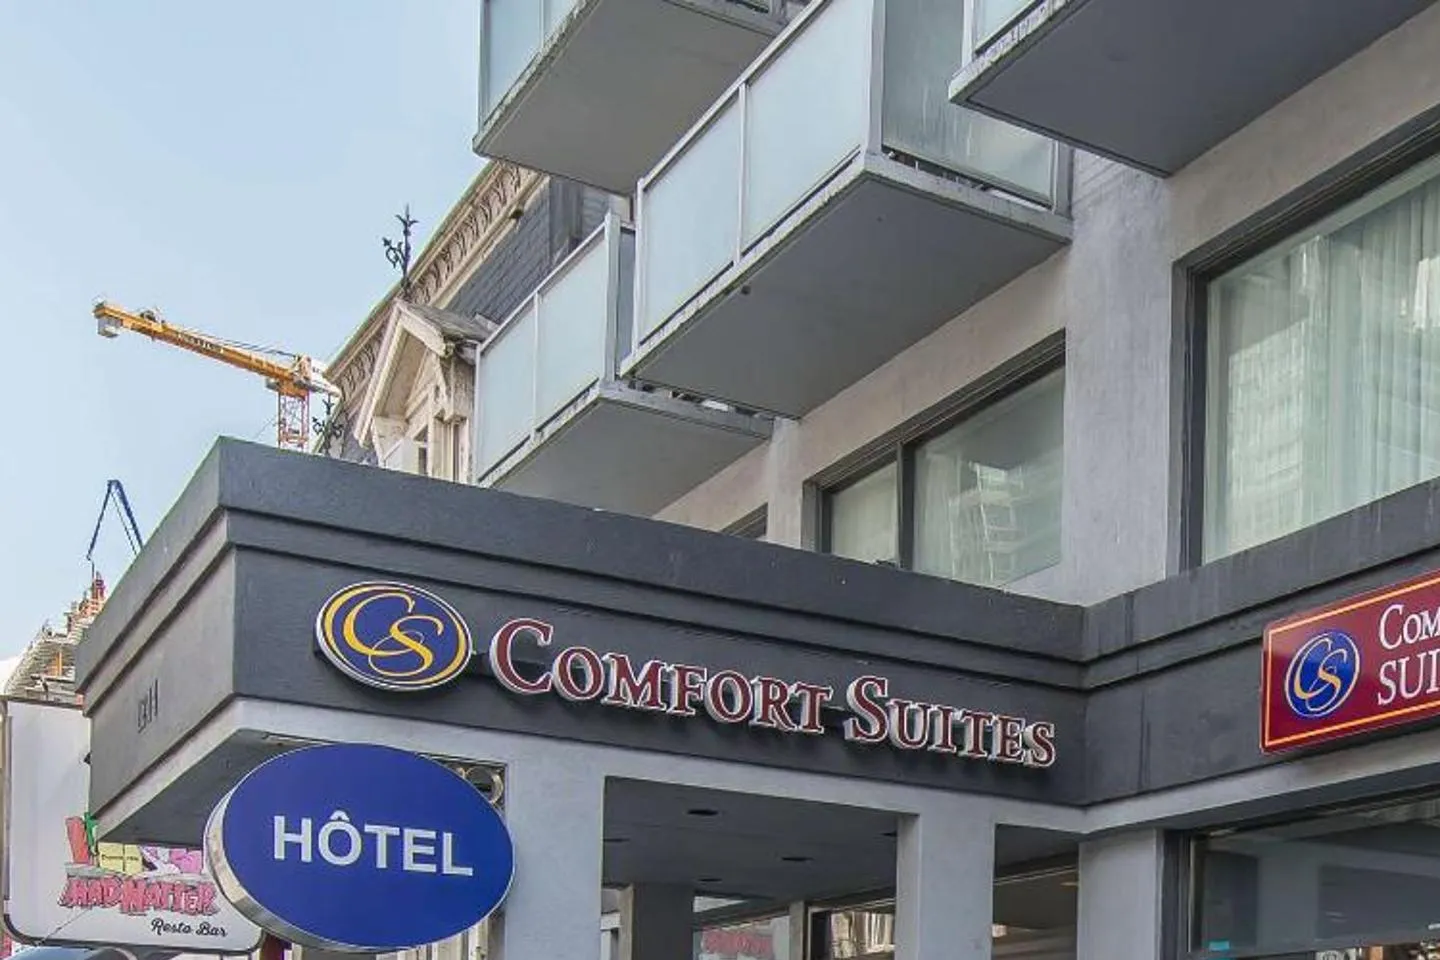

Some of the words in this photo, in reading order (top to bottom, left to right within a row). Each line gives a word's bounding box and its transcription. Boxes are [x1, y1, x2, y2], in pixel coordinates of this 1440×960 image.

[489, 617, 833, 735] COMFORT
[843, 674, 1056, 769] SUITES
[273, 810, 474, 877] HÔTEL
[195, 921, 229, 938] Bar
